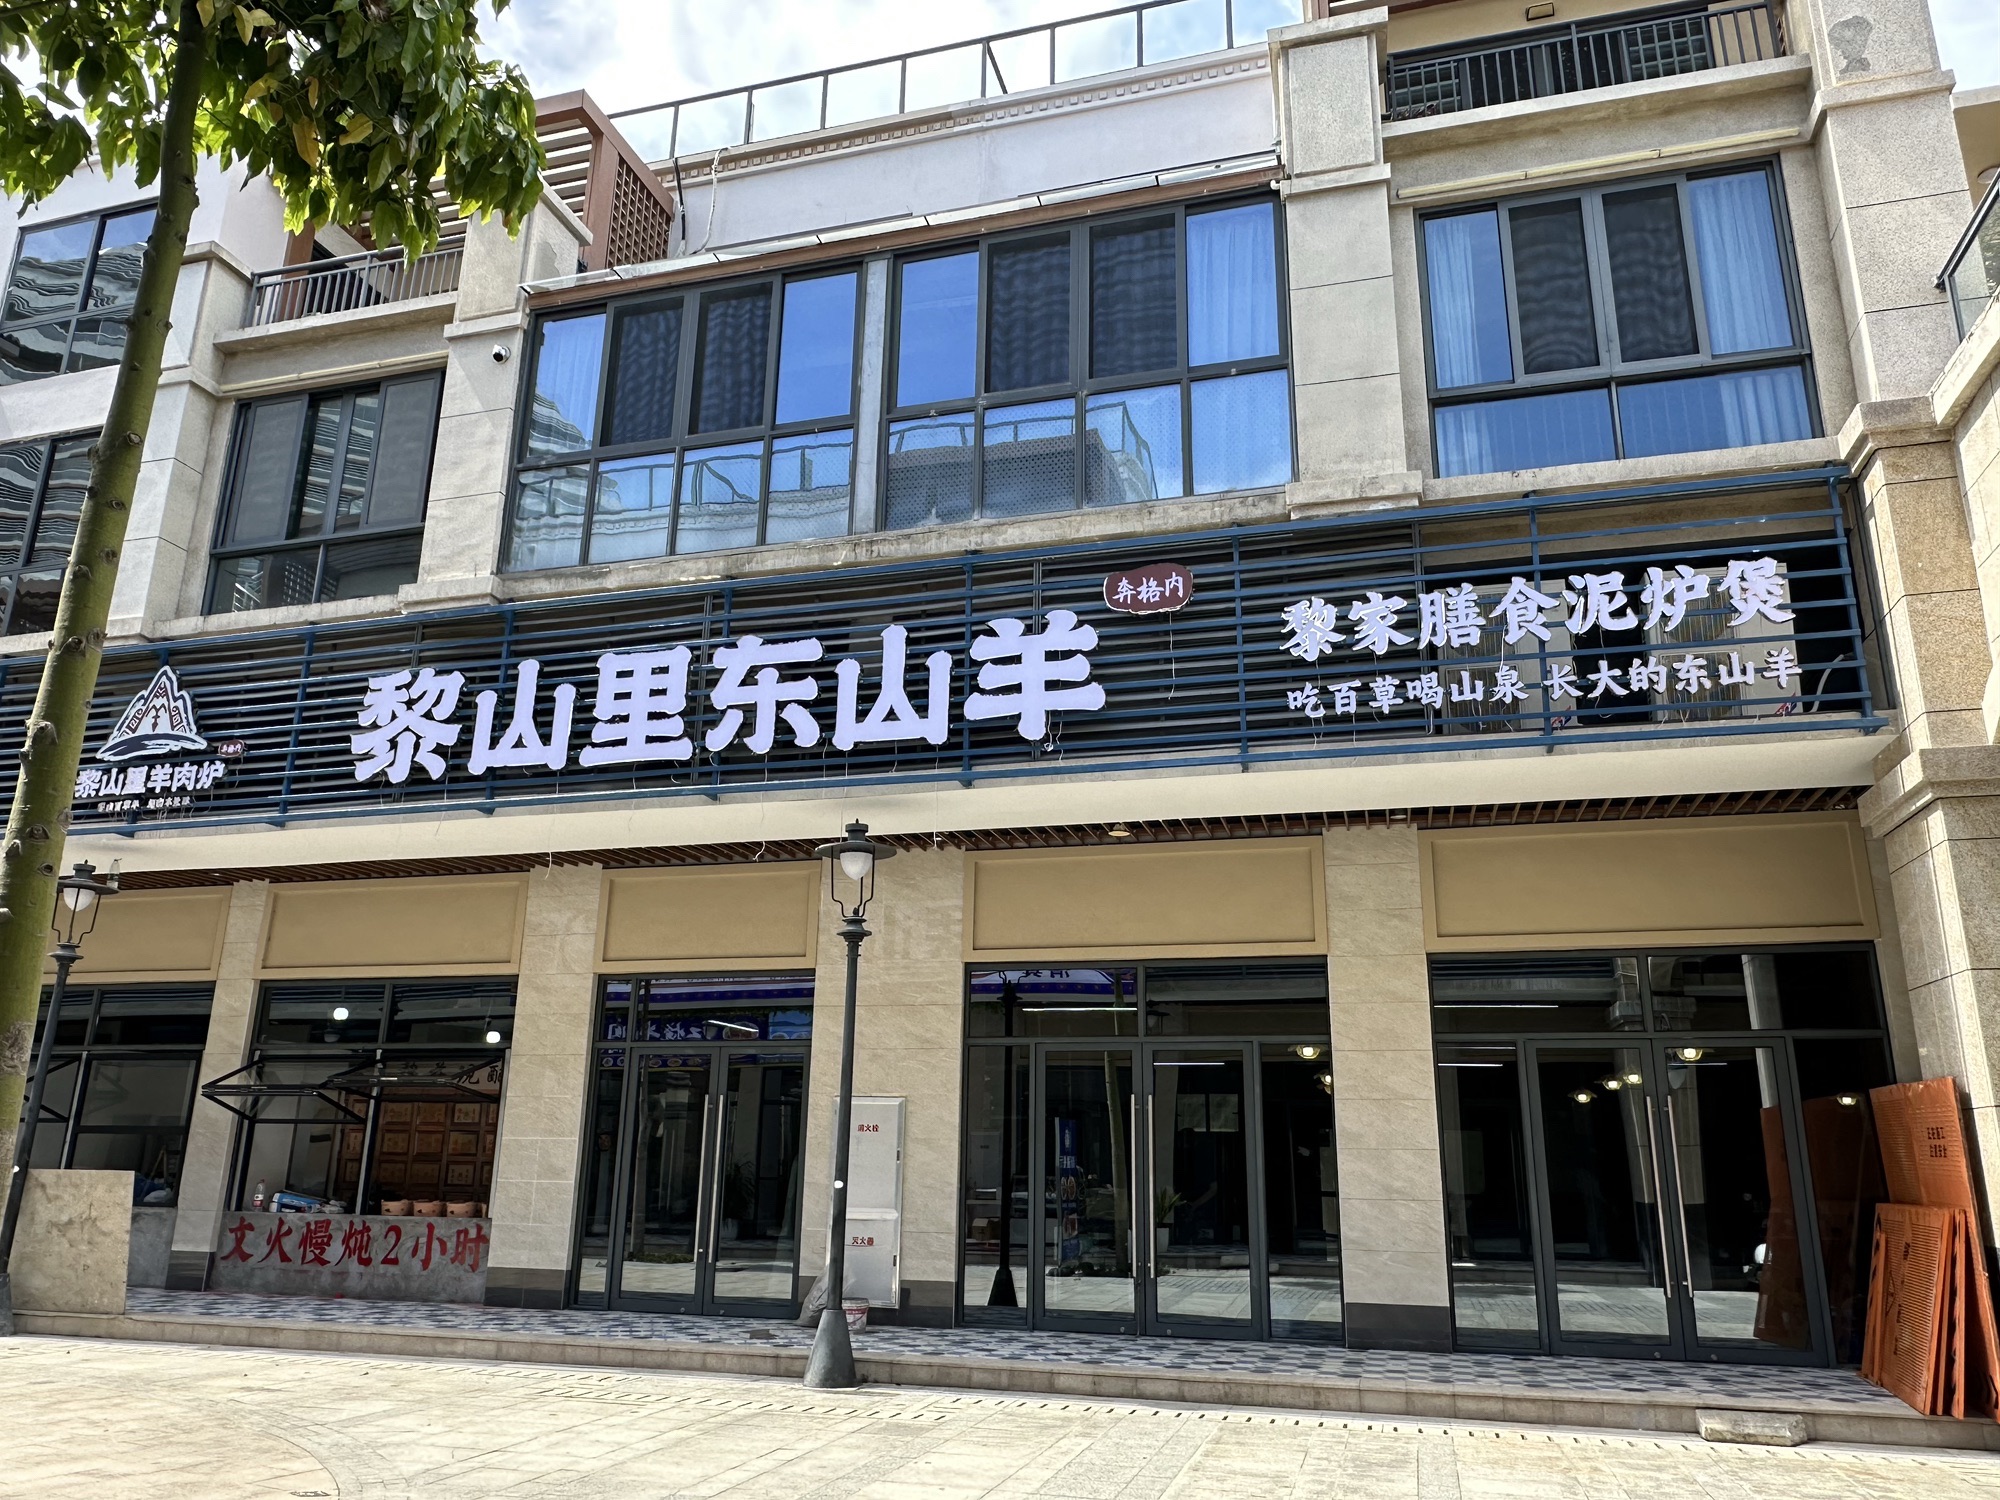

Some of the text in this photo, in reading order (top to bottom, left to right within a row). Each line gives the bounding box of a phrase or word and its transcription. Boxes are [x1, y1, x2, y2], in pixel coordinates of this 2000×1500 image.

[1112, 572, 1184, 605] 奔格内
[1279, 556, 1797, 661] 黎家膳食泥炉煲
[350, 609, 1105, 784] 黎山里东山羊
[74, 760, 226, 798] 黎山里羊肉炉
[220, 1216, 490, 1273] 文火慢炖2小时
[852, 1236, 874, 1246] 灭火器
